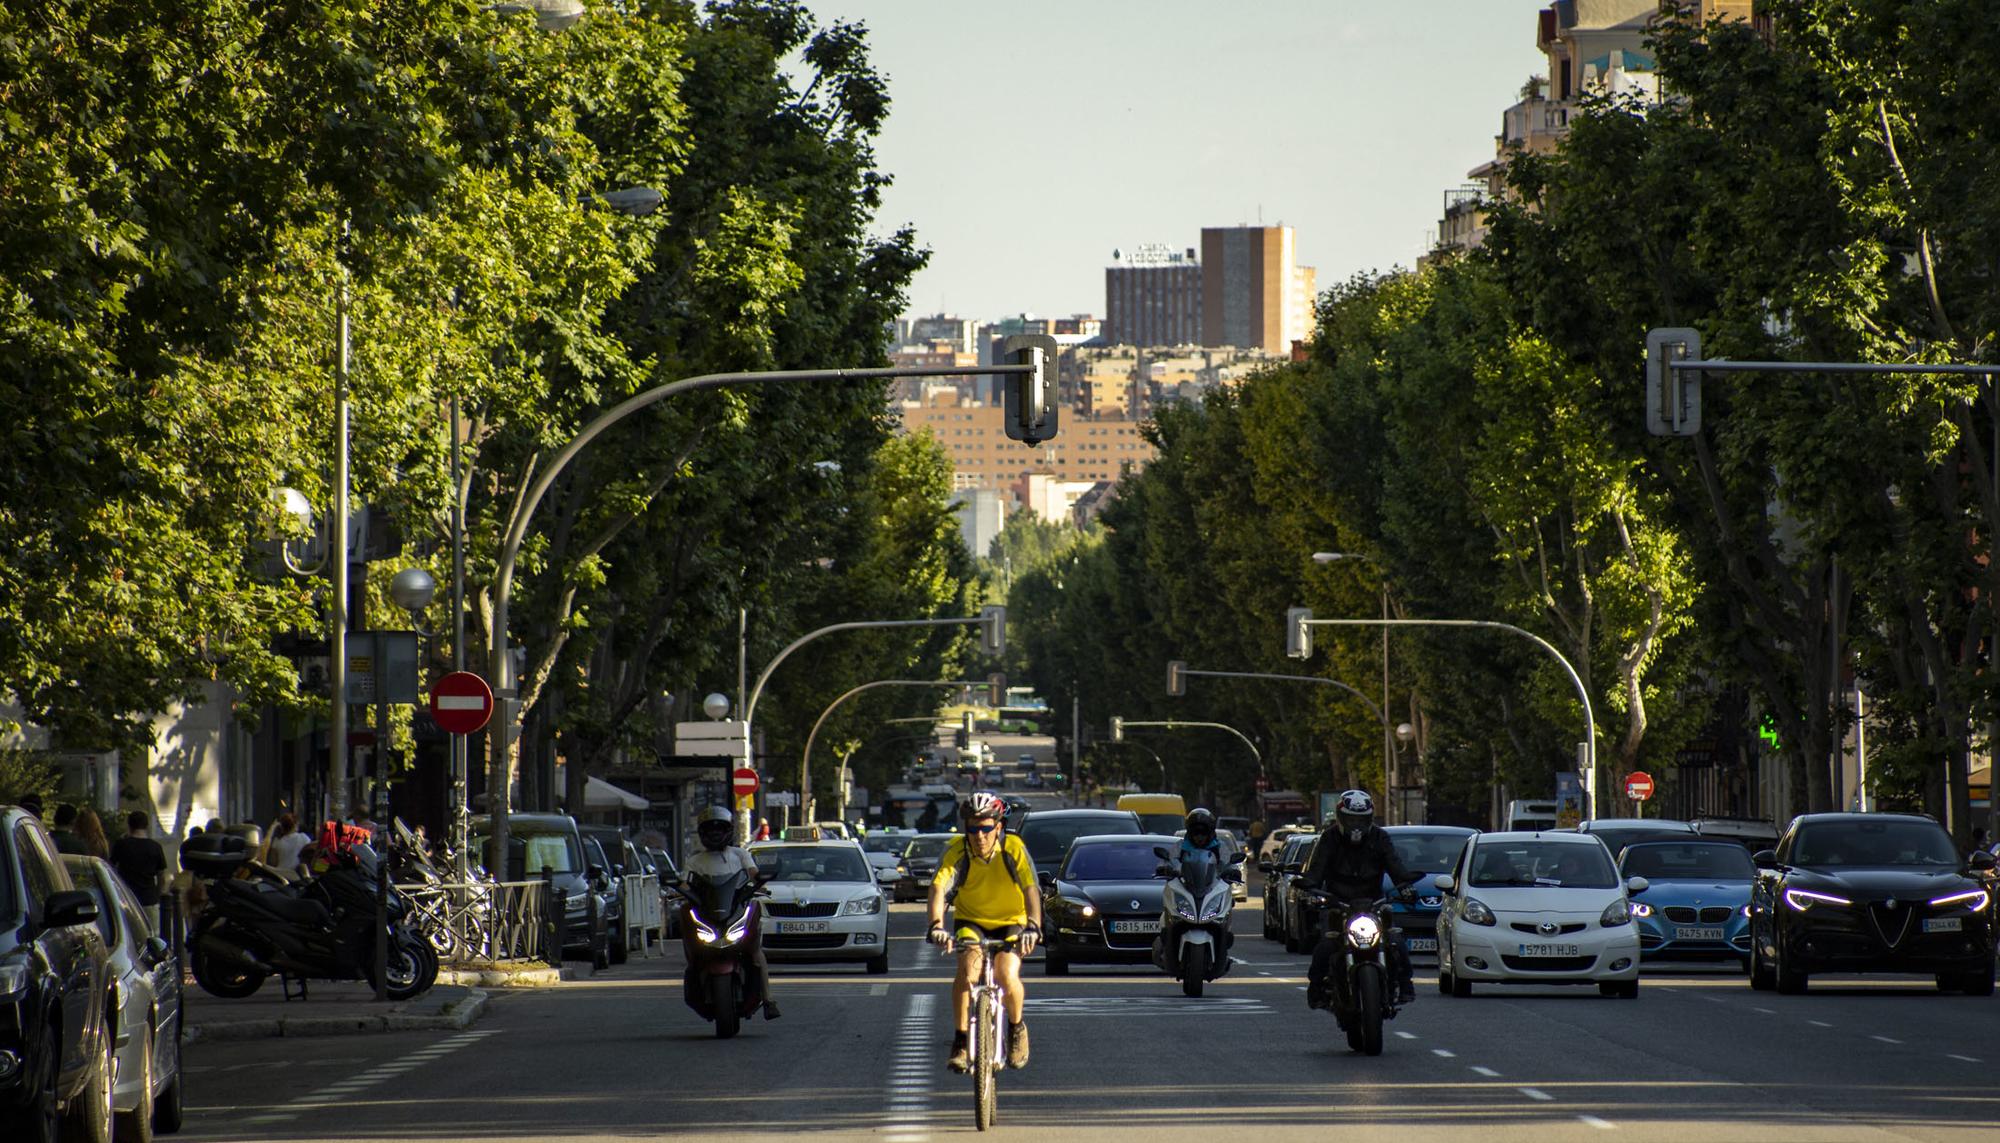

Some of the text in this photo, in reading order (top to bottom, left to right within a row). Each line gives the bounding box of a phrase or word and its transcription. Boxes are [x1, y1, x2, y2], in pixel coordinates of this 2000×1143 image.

[783, 922, 826, 932] 6840 HJR
[1115, 922, 1140, 932] 6815
[1678, 928, 1702, 938] 9475
[1412, 940, 1436, 950] 2248
[1526, 944, 1579, 956] 5781 HJB
